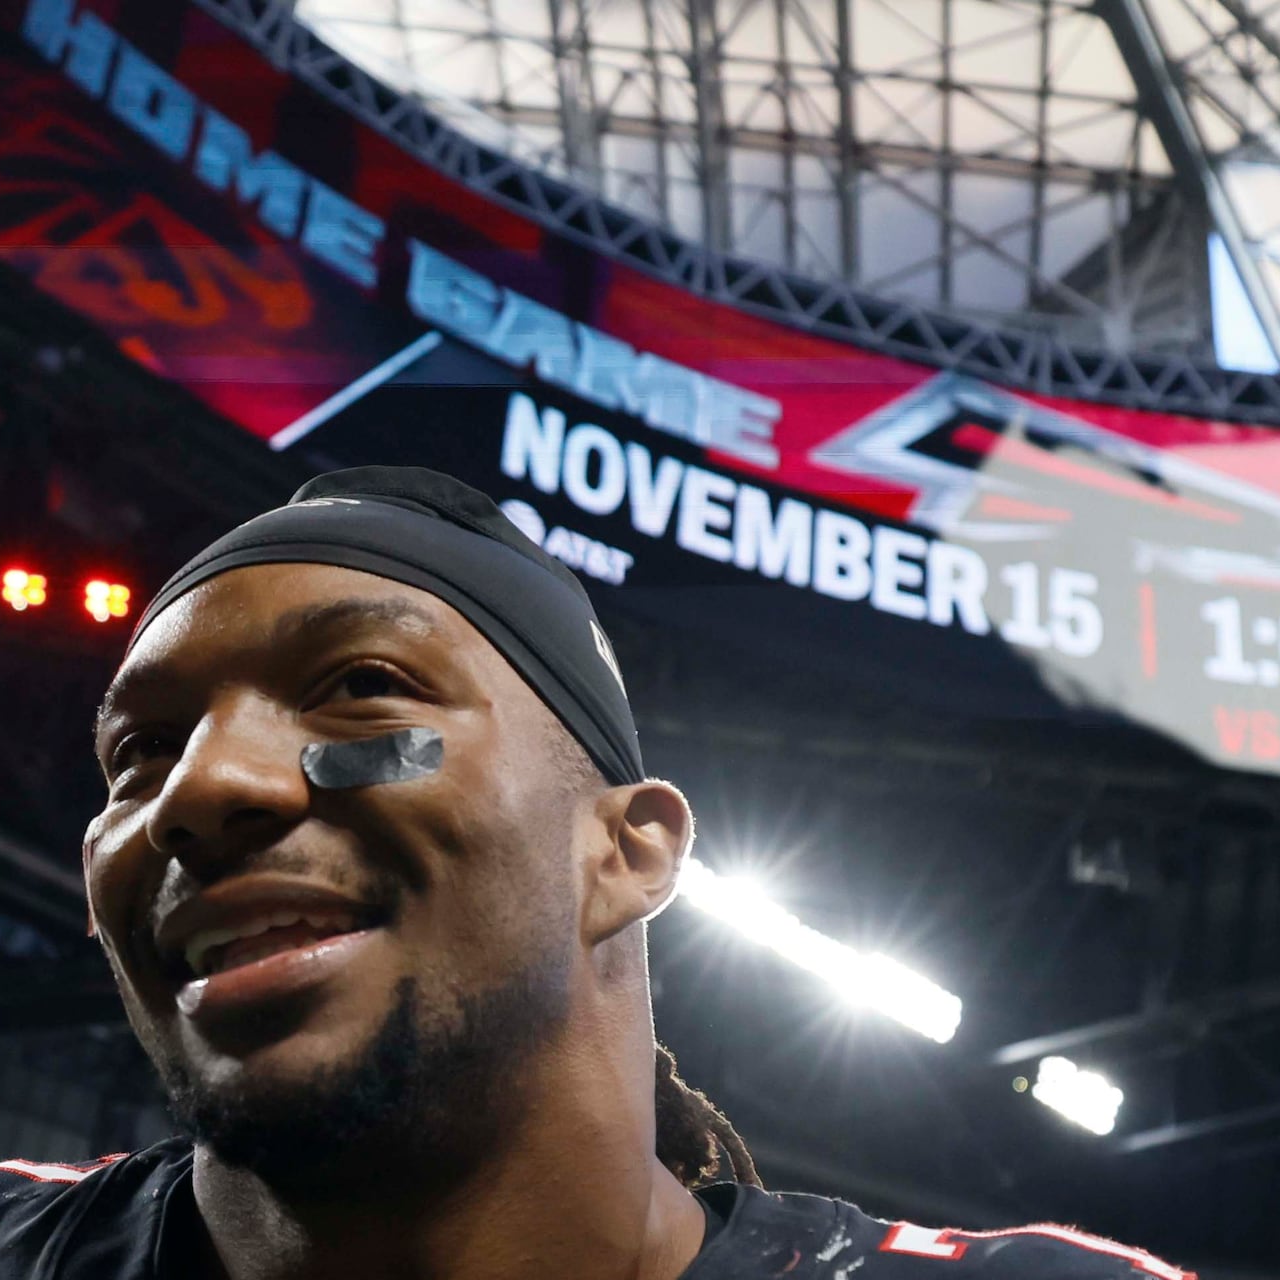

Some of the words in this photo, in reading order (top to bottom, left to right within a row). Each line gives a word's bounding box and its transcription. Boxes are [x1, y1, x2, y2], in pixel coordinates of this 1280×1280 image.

[22, 0, 387, 290] HOME
[407, 236, 783, 471] GAME
[500, 391, 991, 636] NOVEMBER
[1001, 560, 1104, 659] 15
[543, 526, 634, 586] AT&T
